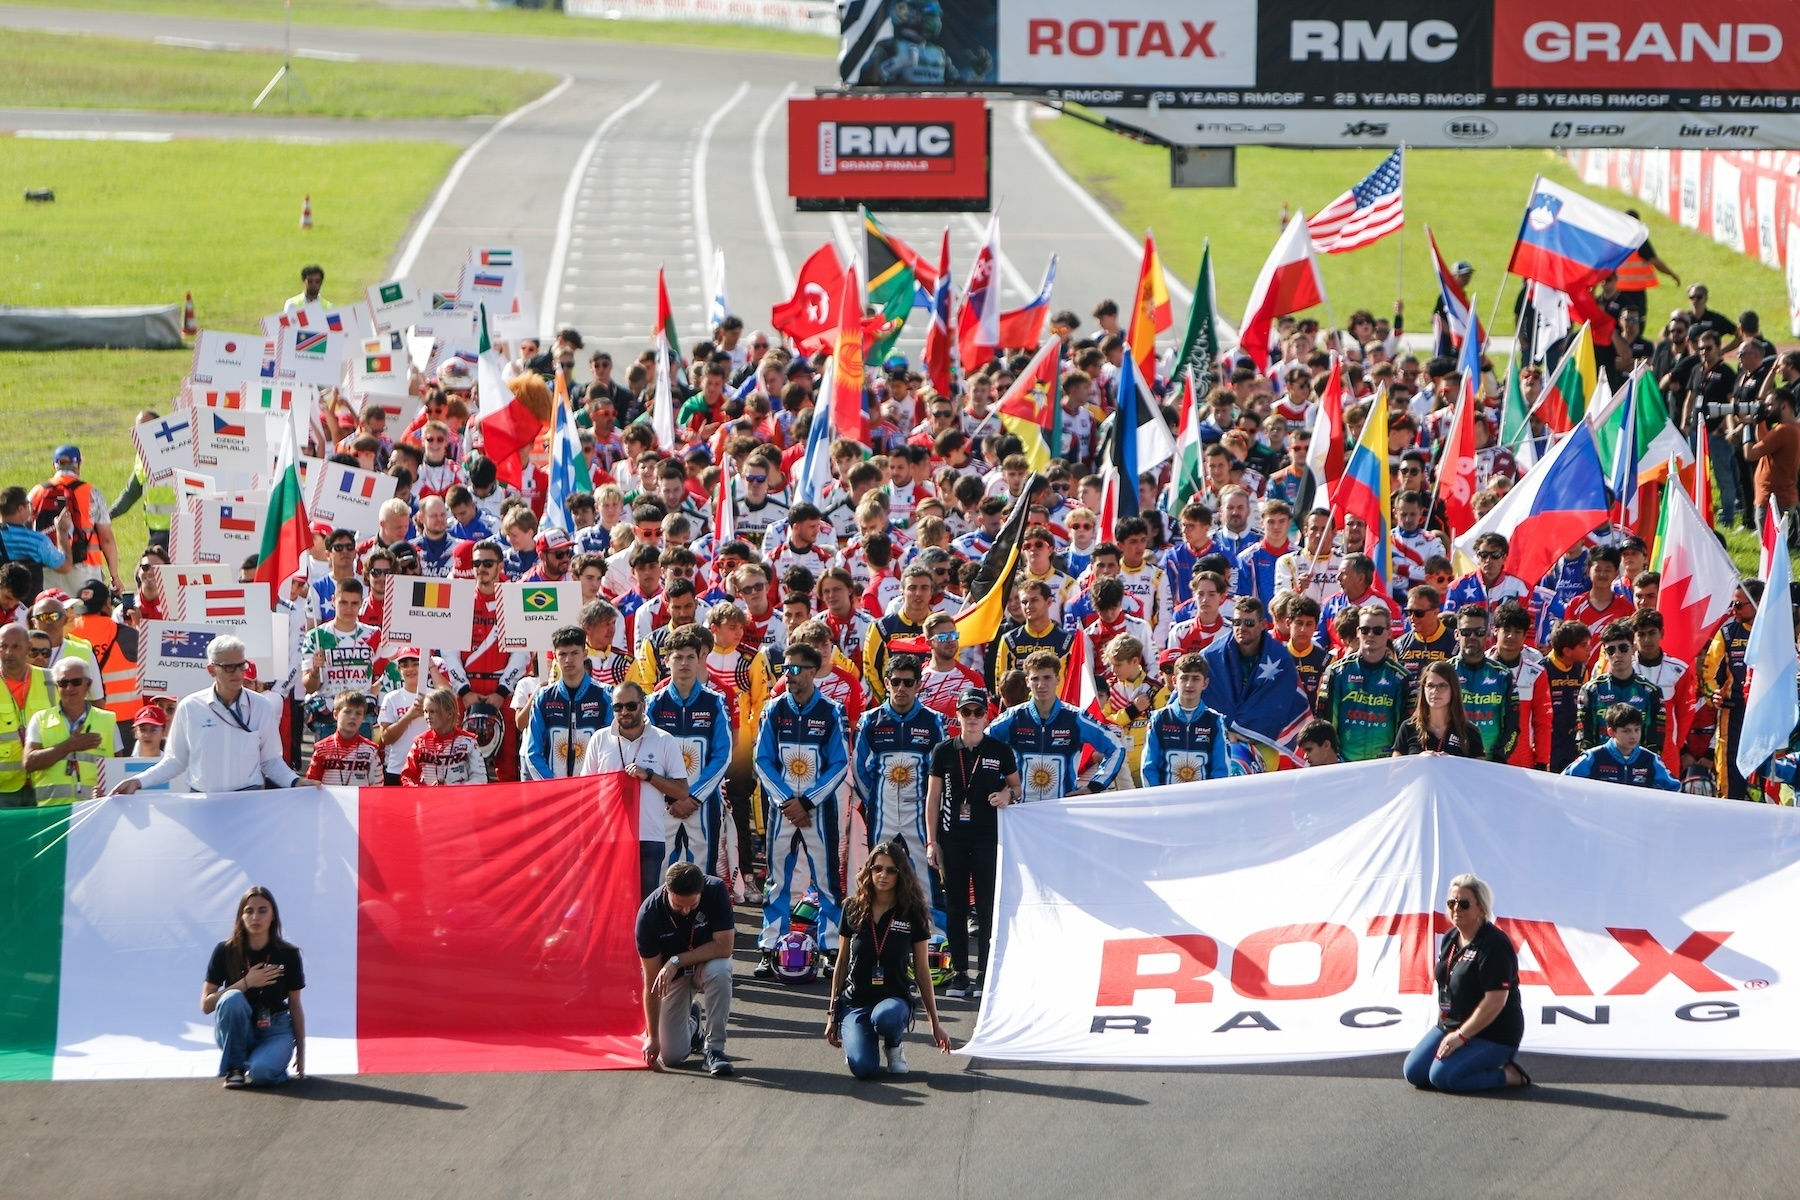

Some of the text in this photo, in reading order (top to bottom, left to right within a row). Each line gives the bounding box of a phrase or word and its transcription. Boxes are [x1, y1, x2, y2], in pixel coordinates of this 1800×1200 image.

[1028, 19, 1217, 58] ROTAX
[1290, 19, 1458, 63] RMC
[1522, 20, 1784, 64] GRAND
[1180, 91, 1240, 104] YEARS
[1244, 92, 1305, 105] RMCGF
[1333, 92, 1357, 106] 25
[1361, 92, 1421, 106] YEARS
[1425, 92, 1487, 106] RMCGF
[1516, 93, 1539, 106] 25
[1543, 93, 1603, 107] YEARS
[1607, 94, 1670, 107] RMCGF
[1699, 95, 1722, 108] 25
[1728, 95, 1788, 108] YEARS
[1341, 120, 1390, 137] XPS
[1450, 121, 1491, 134] BELL
[1679, 123, 1759, 138] birelART
[839, 126, 951, 156] RMC
[839, 160, 929, 171] GRAND FINALS
[215, 358, 242, 366] JAPAN
[216, 437, 244, 445] CZECH
[210, 443, 250, 452] REPUBLIC
[336, 494, 370, 506] FRANCE
[223, 532, 250, 541] CHILE
[200, 552, 219, 560] RMC
[408, 609, 452, 619] BELGIUM
[524, 614, 558, 622] BRAZIL
[389, 632, 411, 641] RMC
[505, 637, 527, 645] RMC
[332, 648, 371, 660] RMC
[1404, 650, 1450, 661] BRASIL
[157, 660, 207, 670] AUSTRAL
[143, 680, 168, 689] RMC
[1551, 678, 1584, 687] BRASIL
[1341, 690, 1394, 707] Australia
[1461, 692, 1503, 705] ustralia
[1347, 709, 1387, 722] ROTAX
[1345, 718, 1387, 728] RACING
[1095, 911, 1736, 1007] ROTAX
[1090, 1001, 1741, 1035] RACNG
